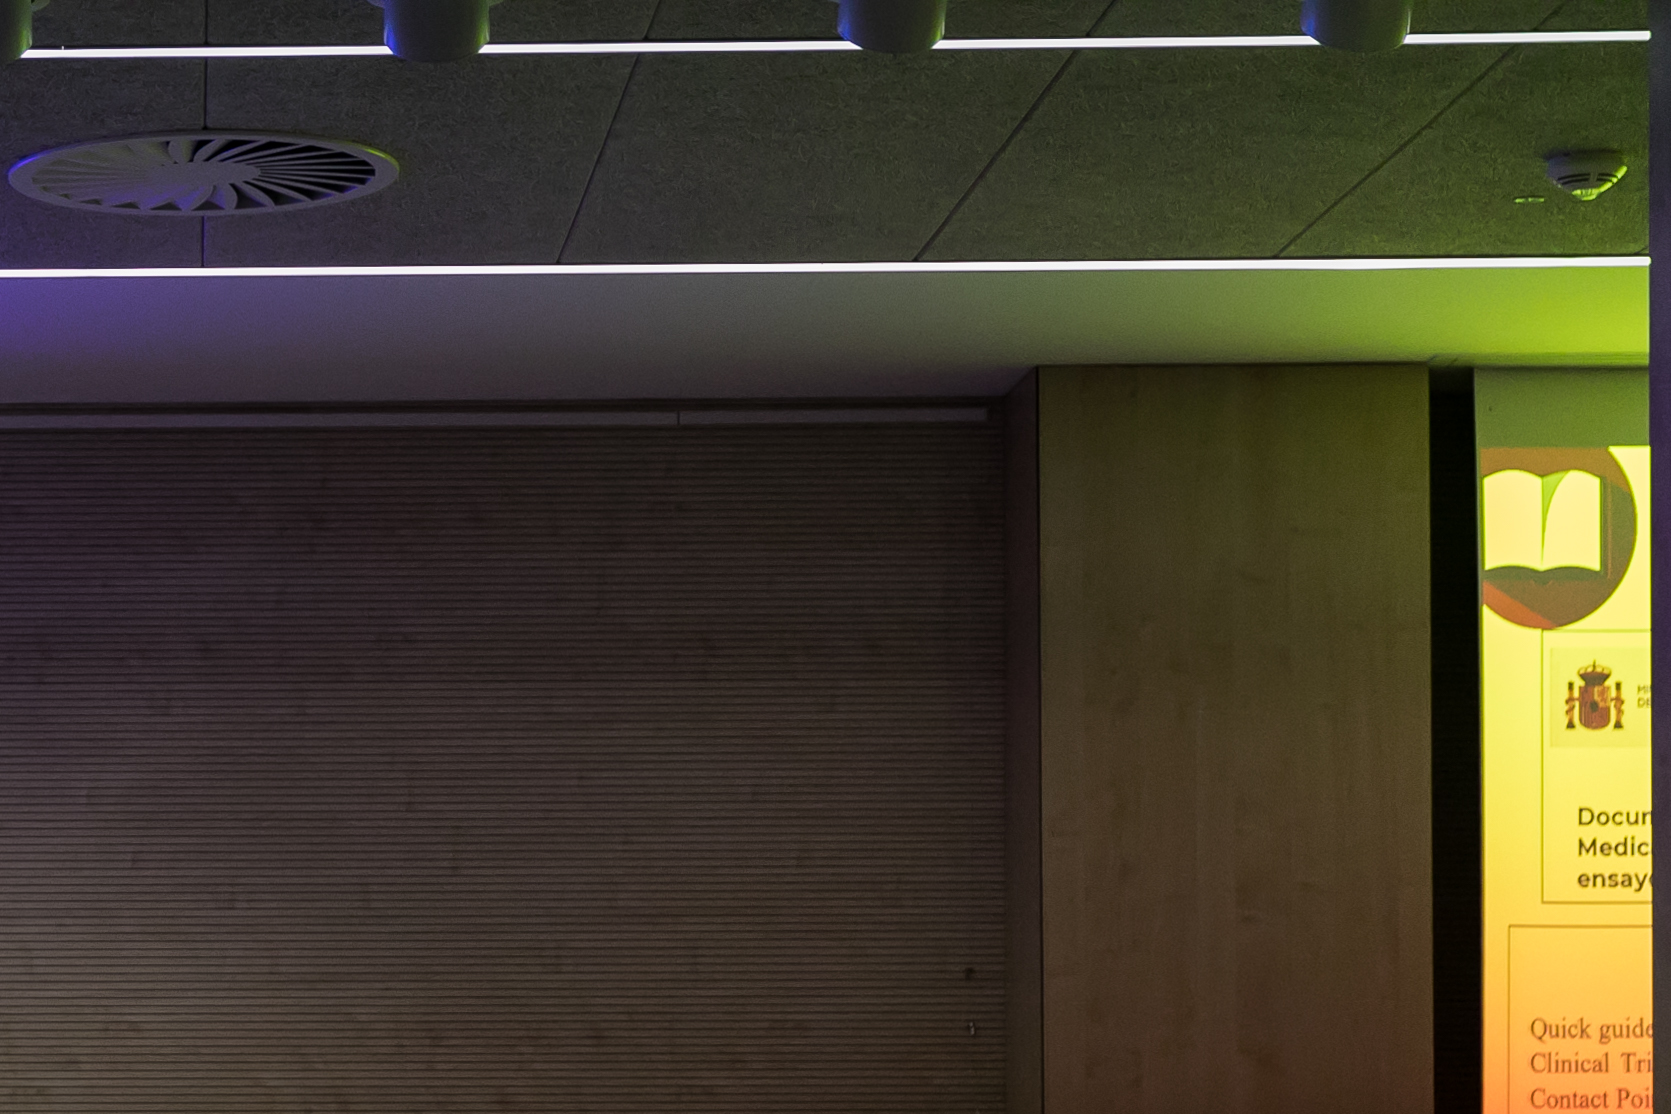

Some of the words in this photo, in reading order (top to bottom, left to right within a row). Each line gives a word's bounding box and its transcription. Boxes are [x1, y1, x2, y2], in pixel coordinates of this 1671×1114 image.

[1530, 1017, 1592, 1045] Quick
[1530, 1051, 1610, 1074] Clinical
[1530, 1087, 1609, 1110] Contact
